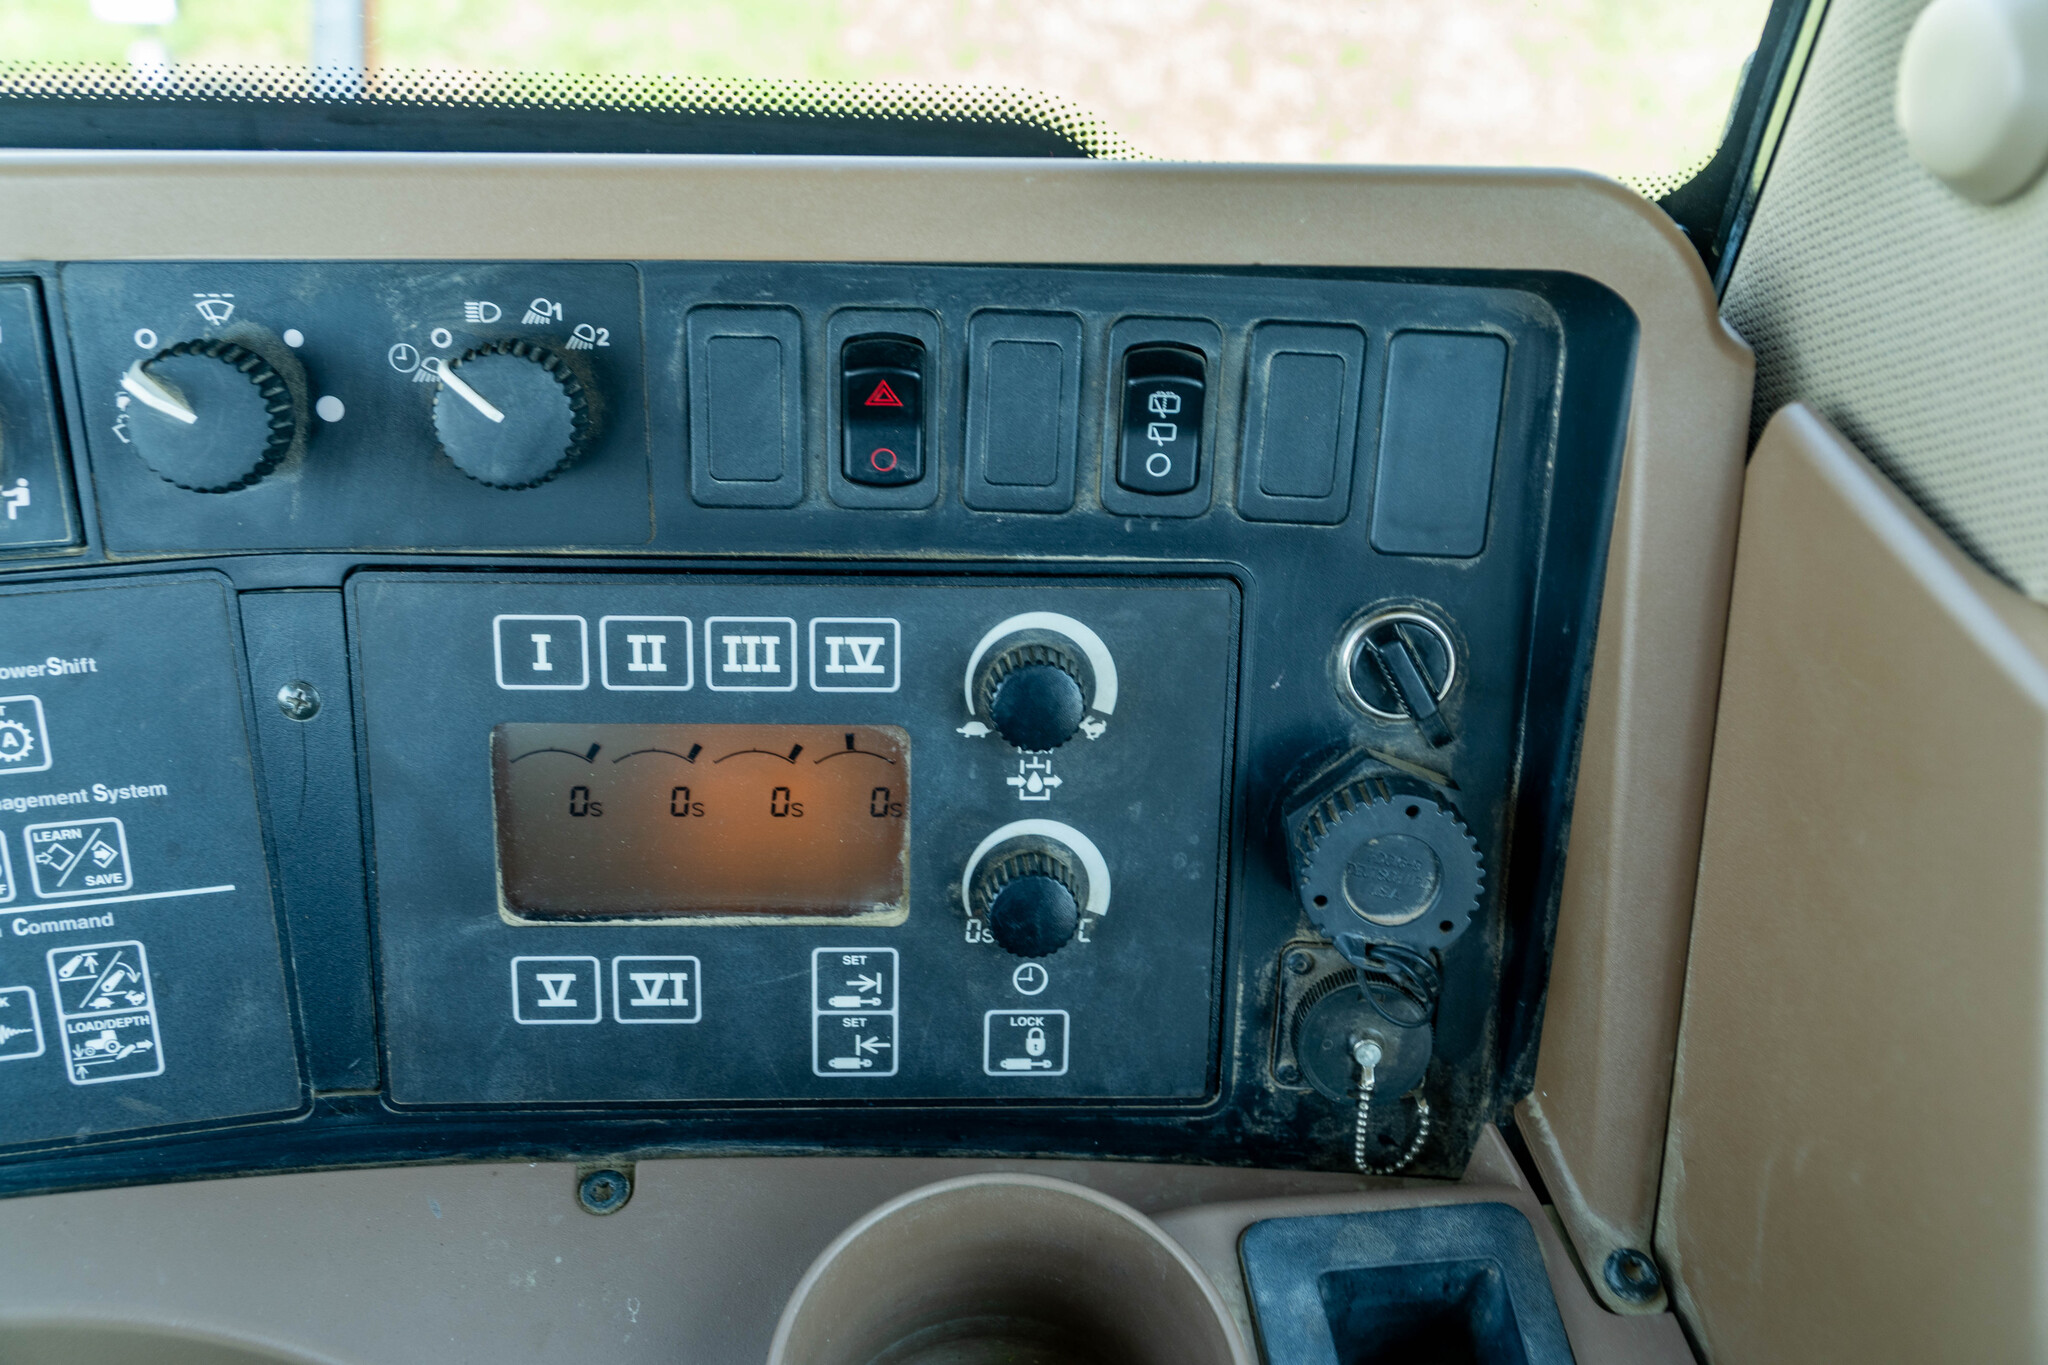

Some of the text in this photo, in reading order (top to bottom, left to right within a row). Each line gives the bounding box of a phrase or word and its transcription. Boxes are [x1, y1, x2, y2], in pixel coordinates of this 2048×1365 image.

[552, 302, 563, 322] 1
[596, 327, 610, 347] 2
[530, 633, 553, 672] I
[626, 634, 668, 672] II
[721, 635, 781, 673] III
[824, 636, 885, 674] IV
[2, 732, 20, 748] A
[92, 783, 168, 804] System
[32, 828, 83, 843] LEARN
[85, 873, 124, 887] SAVE
[12, 911, 115, 937] Command
[842, 955, 867, 966] SET
[535, 973, 577, 1008] V
[629, 972, 688, 1007] VI
[67, 1014, 151, 1034] LOAD/DEPTH
[842, 1017, 867, 1029] SET
[1009, 1016, 1045, 1028] LOCK
